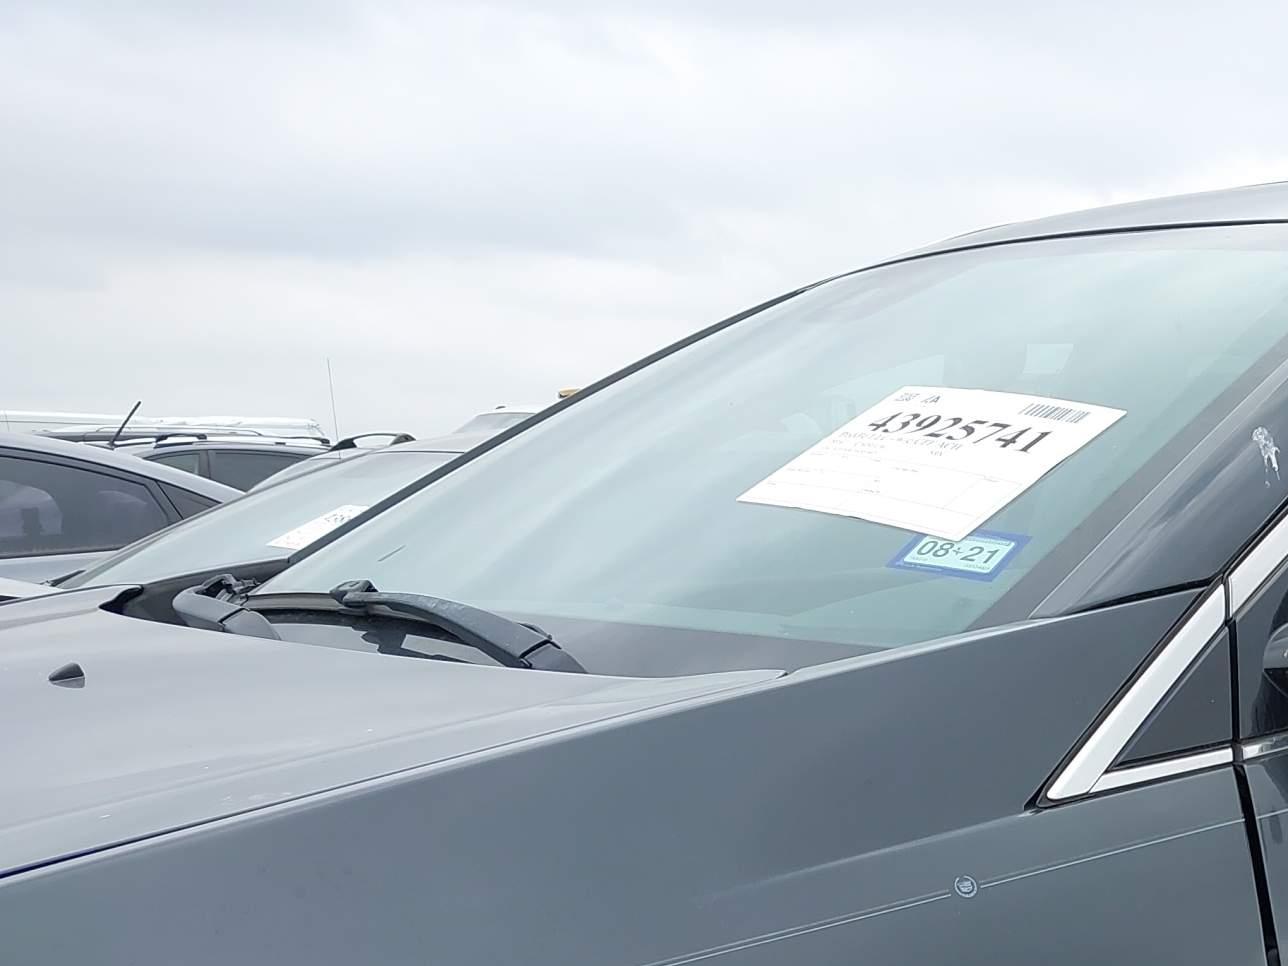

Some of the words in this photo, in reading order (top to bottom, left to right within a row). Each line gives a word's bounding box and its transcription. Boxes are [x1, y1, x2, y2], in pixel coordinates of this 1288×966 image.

[867, 411, 1053, 453] 43925741
[916, 540, 955, 558] 08
[959, 545, 1001, 564] 21
